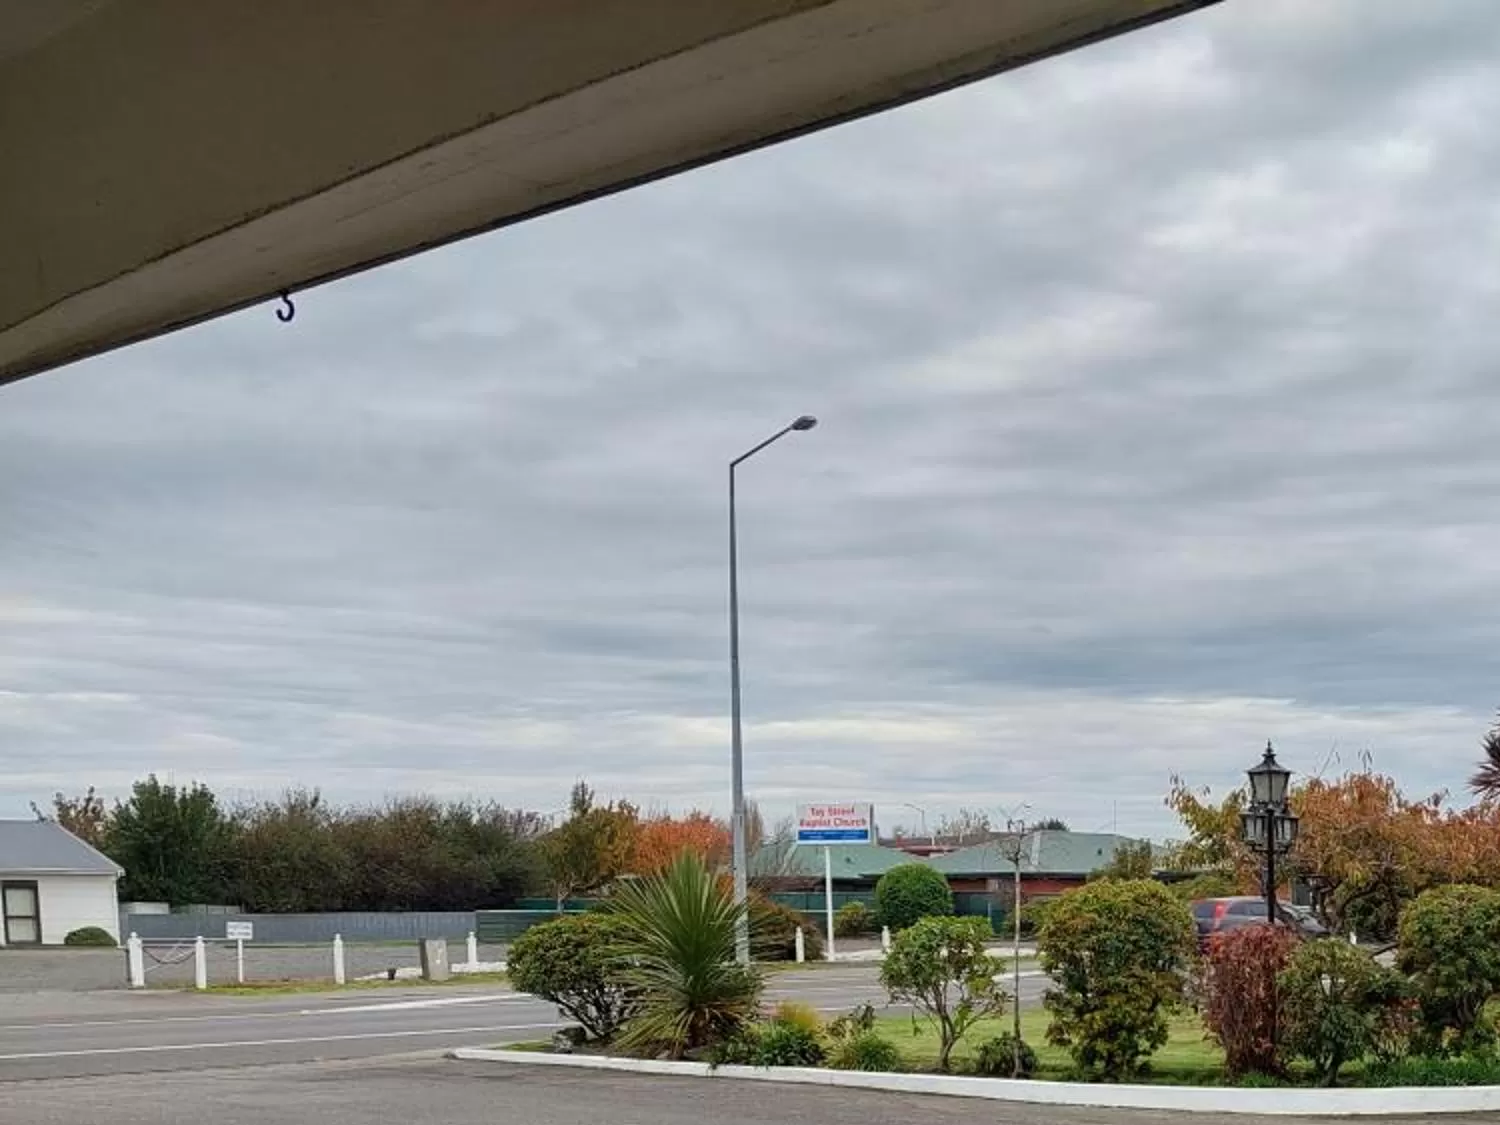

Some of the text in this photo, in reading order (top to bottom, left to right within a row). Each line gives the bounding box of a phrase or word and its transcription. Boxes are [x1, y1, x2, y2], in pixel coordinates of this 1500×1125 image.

[828, 806, 855, 816] Street
[799, 818, 867, 828] Baptist Church
